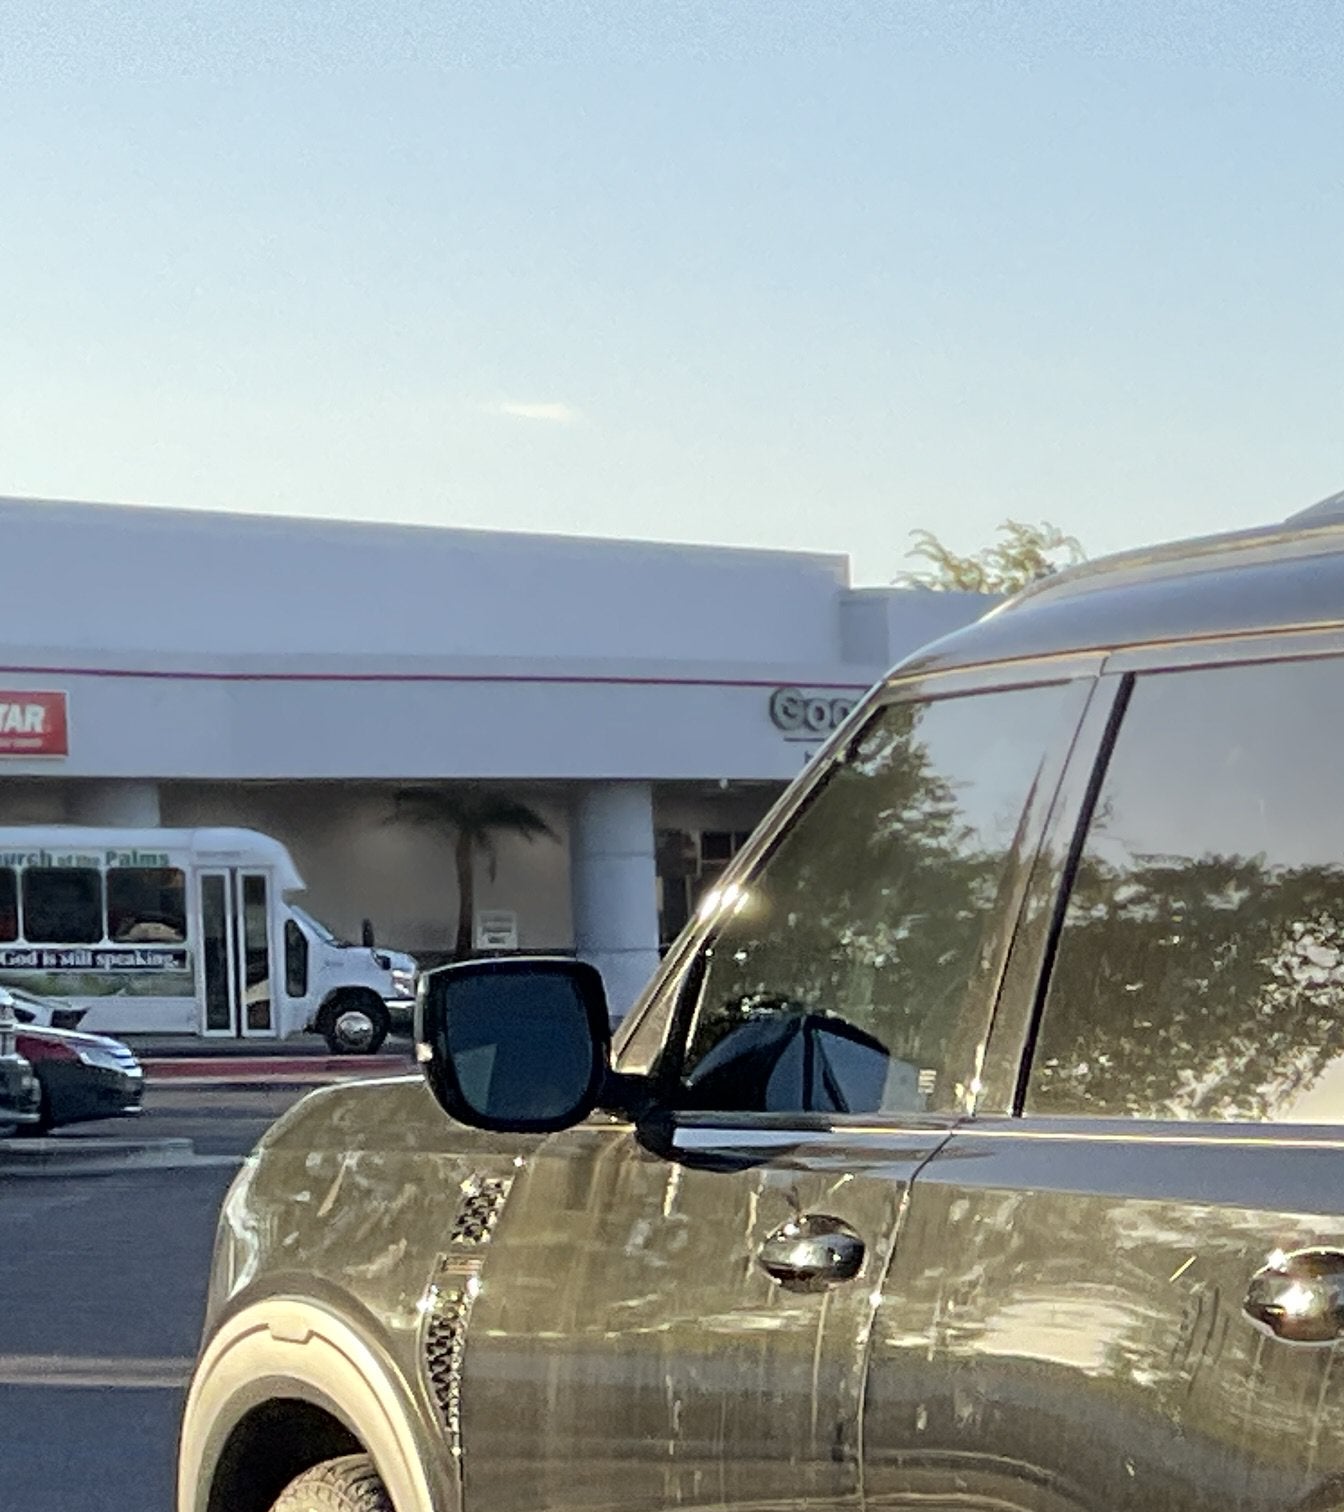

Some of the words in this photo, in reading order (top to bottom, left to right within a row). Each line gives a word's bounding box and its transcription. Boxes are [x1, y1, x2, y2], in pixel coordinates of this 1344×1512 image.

[0, 849, 52, 867] urch
[106, 850, 170, 867] Palms
[2, 951, 38, 966] God
